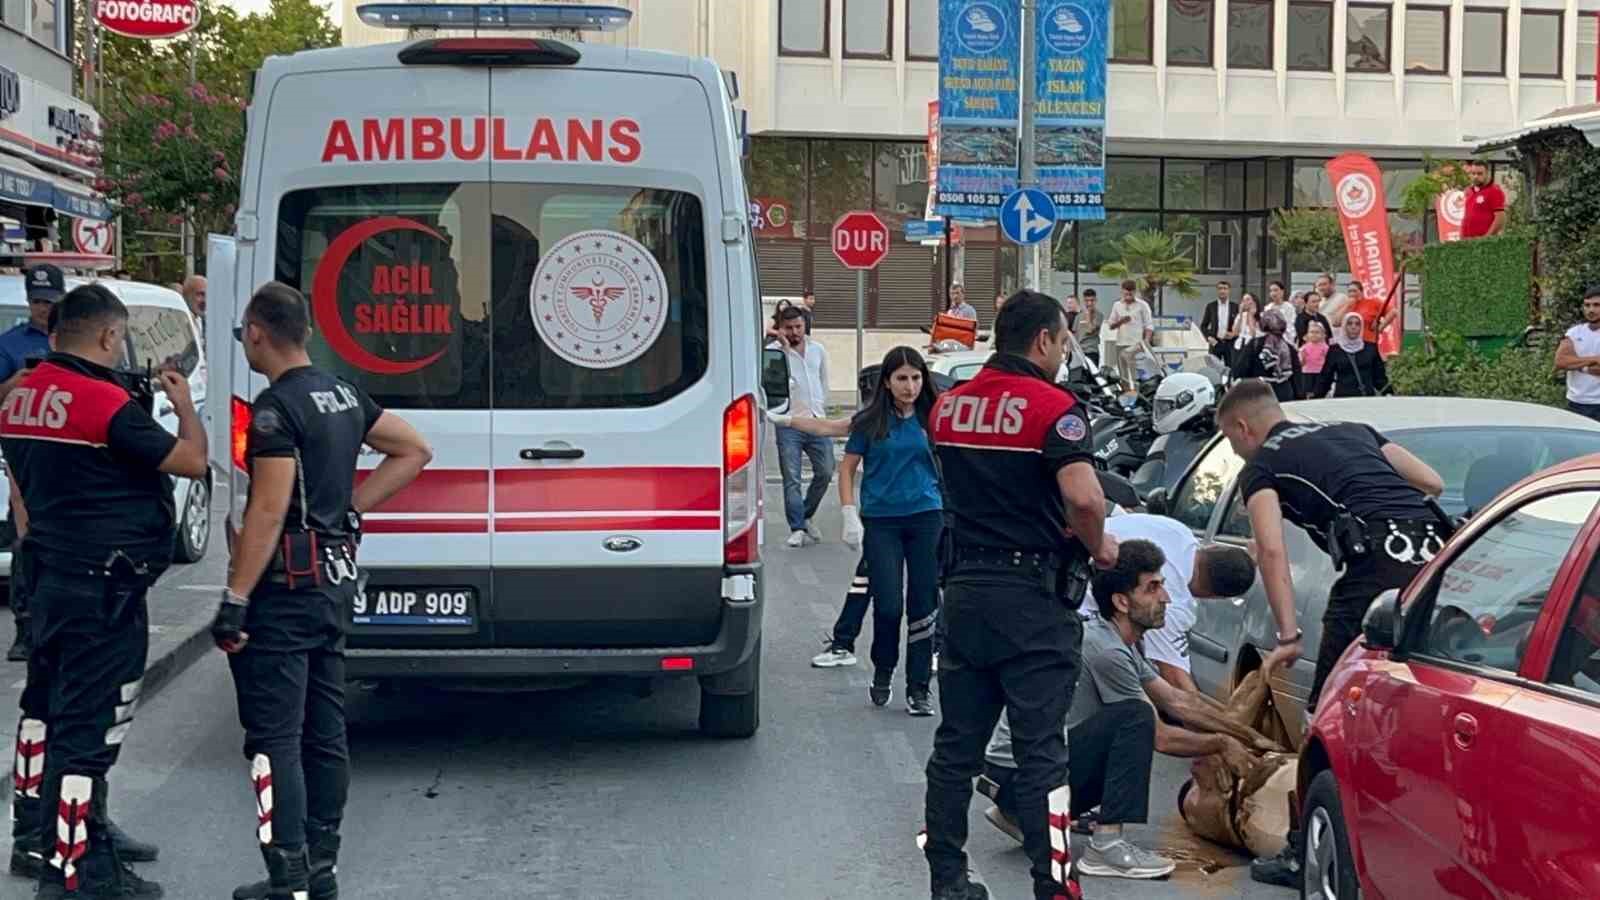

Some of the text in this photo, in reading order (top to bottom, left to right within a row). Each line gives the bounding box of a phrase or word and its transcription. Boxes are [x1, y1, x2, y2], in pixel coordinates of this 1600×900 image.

[321, 117, 641, 163] AMBULANS
[967, 194, 986, 204] 105
[1053, 194, 1072, 204] 105
[837, 229, 884, 252] DUR
[354, 297, 455, 333] SAĞLIK
[936, 391, 1028, 435] POLİS
[375, 591, 417, 614] ADP
[425, 592, 467, 615] 909
